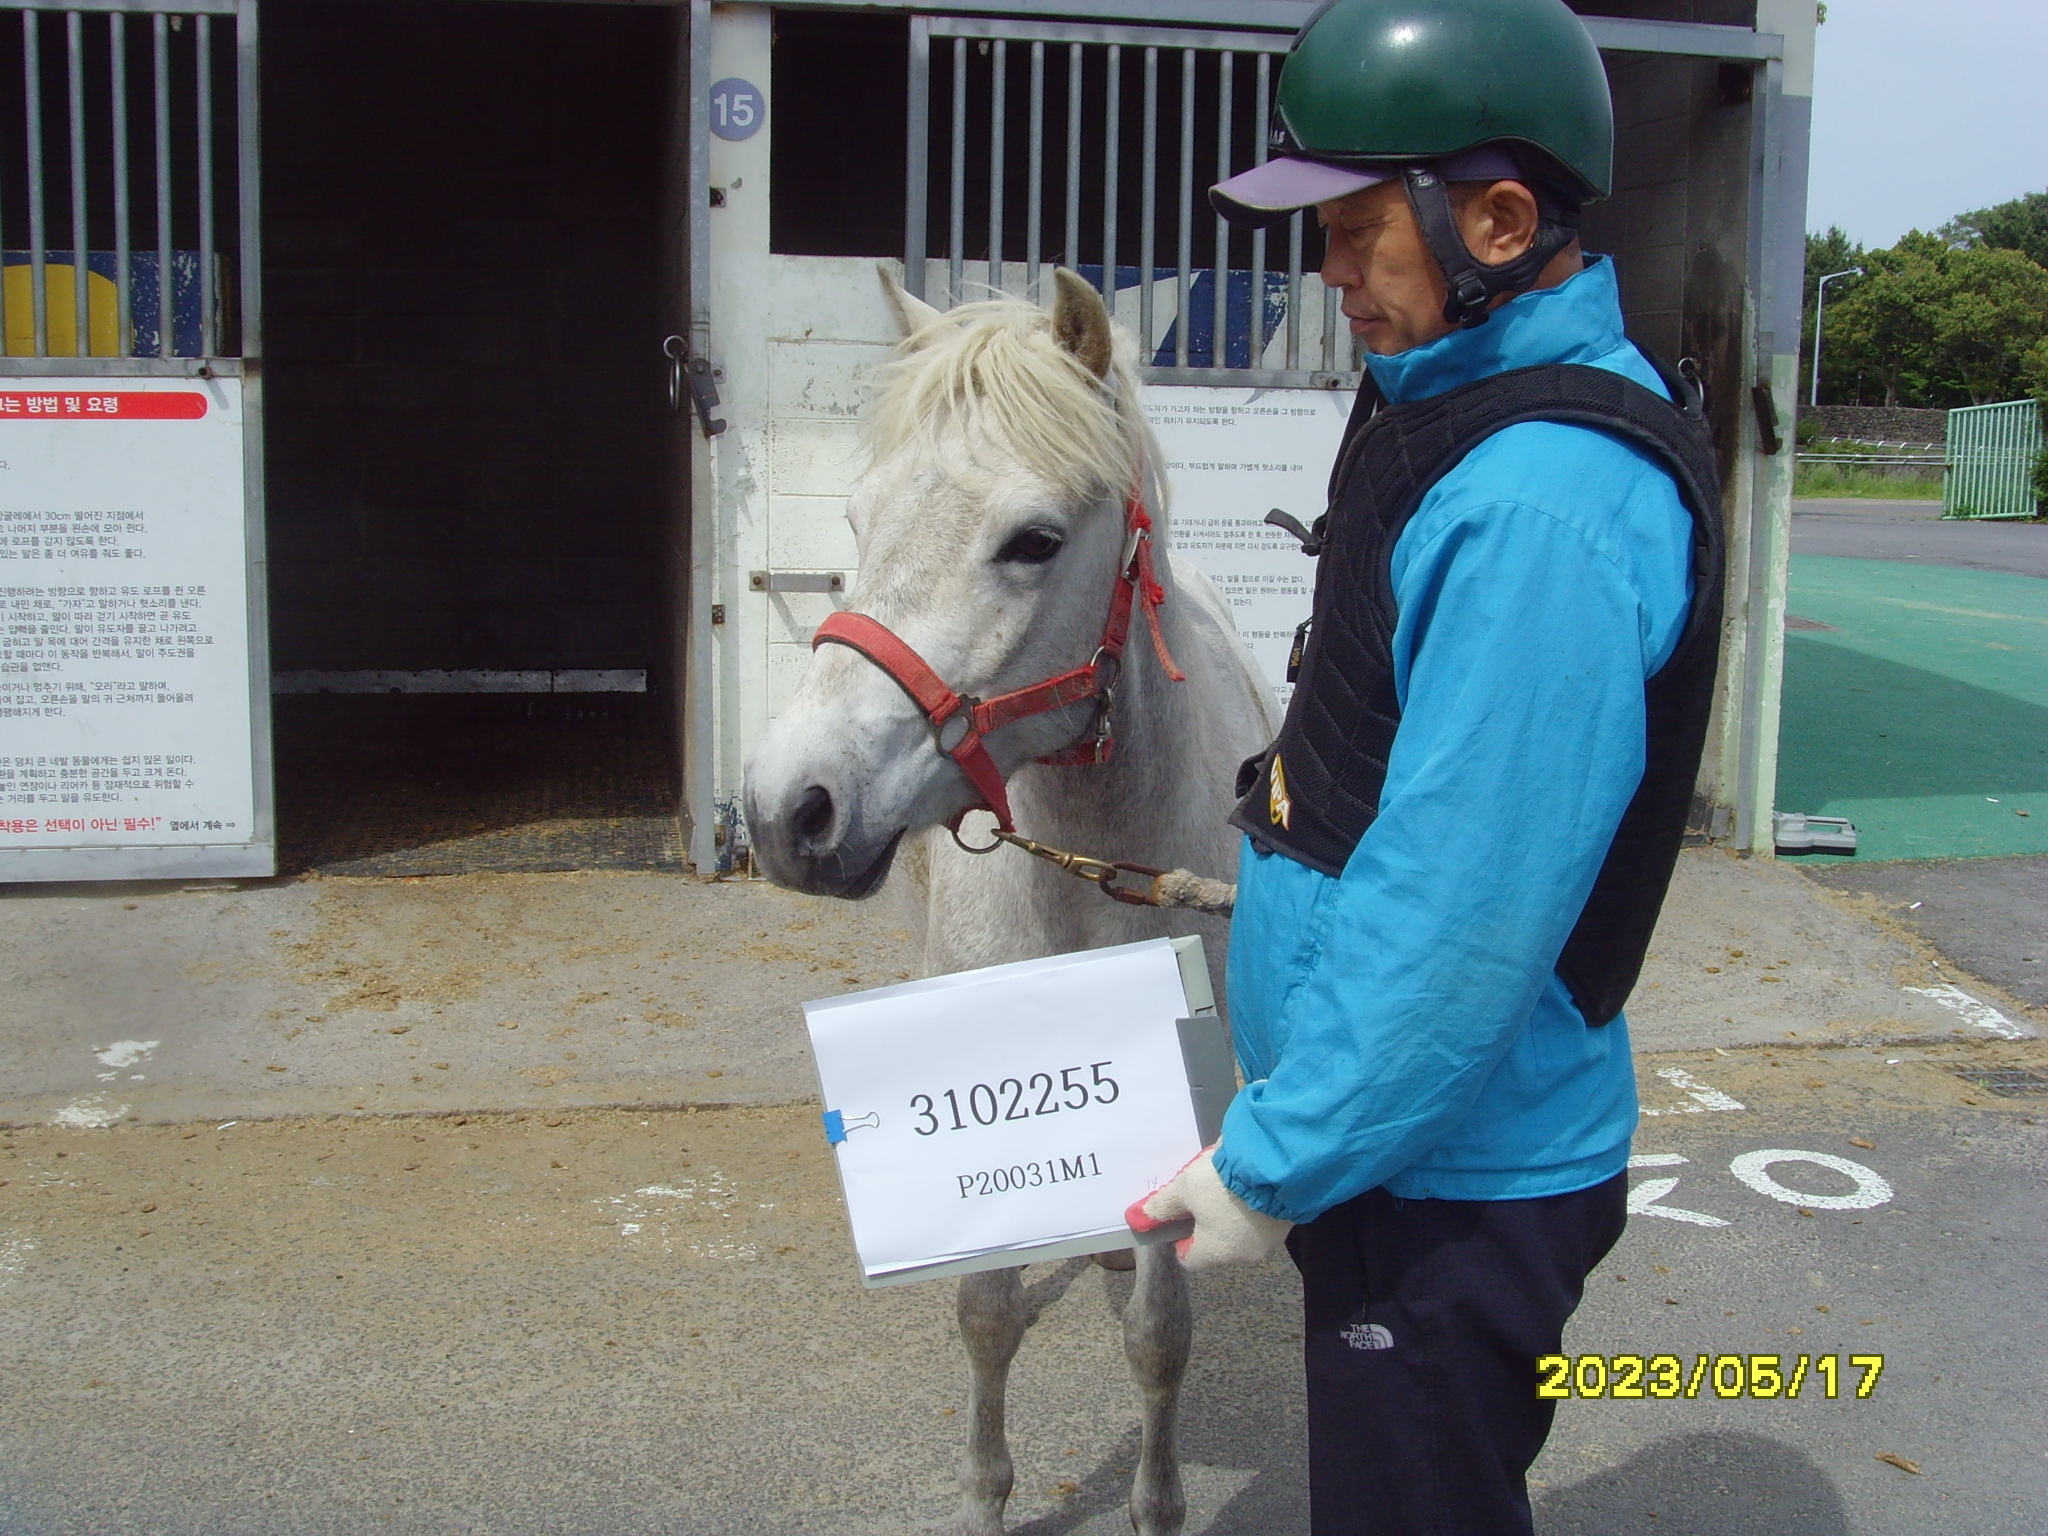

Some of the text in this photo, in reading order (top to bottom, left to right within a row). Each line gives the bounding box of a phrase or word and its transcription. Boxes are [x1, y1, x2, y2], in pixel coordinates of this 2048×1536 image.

[714, 93, 754, 126] 15
[0, 397, 117, 413] 는 방법 및 요령
[0, 510, 143, 521] 굴레에서 30cm 떨어진 지점에서
[7, 523, 36, 534] 나머지
[39, 523, 68, 533] 부분을
[71, 523, 99, 533] 왼손에
[102, 523, 122, 533] 모아
[11, 535, 119, 546] 로프를 감지 않도록 한다.
[21, 548, 40, 559] 말은
[44, 548, 53, 559] 좀
[57, 548, 66, 558] 더
[70, 548, 98, 559] 여유를
[124, 548, 145, 559] 좋다.
[47, 586, 86, 597] 방향으로
[88, 586, 117, 596] 향하고
[120, 585, 139, 596] 유도
[142, 585, 171, 596] 로프를
[186, 585, 206, 596] 오른
[10, 599, 29, 610] 내민
[98, 598, 136, 609] 말하거나
[180, 598, 201, 608] 낸다.
[51, 611, 70, 622] 말이
[74, 611, 93, 621] 따라
[96, 611, 115, 622] 걷기
[118, 611, 155, 621] 시작하면
[171, 610, 191, 620] 유도
[39, 624, 71, 634] 줄인다.
[74, 624, 93, 634] 말이
[96, 623, 134, 634] 유도자를
[159, 623, 197, 633] 나가려고
[1, 635, 214, 647] 굽히고 말 목에 대어 간격을 유지한 채로 왼쪽으로
[15, 649, 44, 659] 때마다
[47, 649, 57, 659] 이
[60, 648, 88, 659] 동작을
[135, 648, 154, 658] 말이
[157, 647, 195, 658] 주도권을
[32, 681, 61, 693] 멈추기
[40, 694, 78, 704] 오른손을
[81, 694, 100, 704] 말의
[103, 693, 112, 704] 귀
[115, 693, 153, 703] 근처까지
[156, 692, 193, 703] 들어올려
[43, 706, 65, 717] 한다.
[37, 756, 46, 766] 큰
[49, 756, 68, 766] 네발
[71, 755, 118, 766] 동물에게는
[121, 755, 140, 765] 쉽지
[143, 754, 162, 765] 않은
[165, 754, 196, 764] 일이다.
[59, 768, 87, 779] 충분한
[90, 767, 118, 778] 공간을
[122, 767, 141, 777] 두고
[144, 767, 162, 776] 크게
[165, 766, 187, 777] 돈다.
[19, 778, 194, 791] 연장이나 리어카 등 잠재적으로 위험할 수
[7, 793, 35, 803] 거리를
[38, 793, 58, 803] 두고
[60, 792, 80, 803] 말을
[82, 792, 122, 802] 유도한다.
[44, 818, 84, 832] 선택이
[90, 818, 120, 831] 아닌
[169, 820, 222, 831] 옆에서 계속
[909, 1061, 1120, 1137] 3102255
[956, 1152, 1103, 1199] P20031M1
[1350, 1324, 1370, 1333] THE
[1340, 1330, 1373, 1342] NORTH
[1349, 1339, 1374, 1349] FACE
